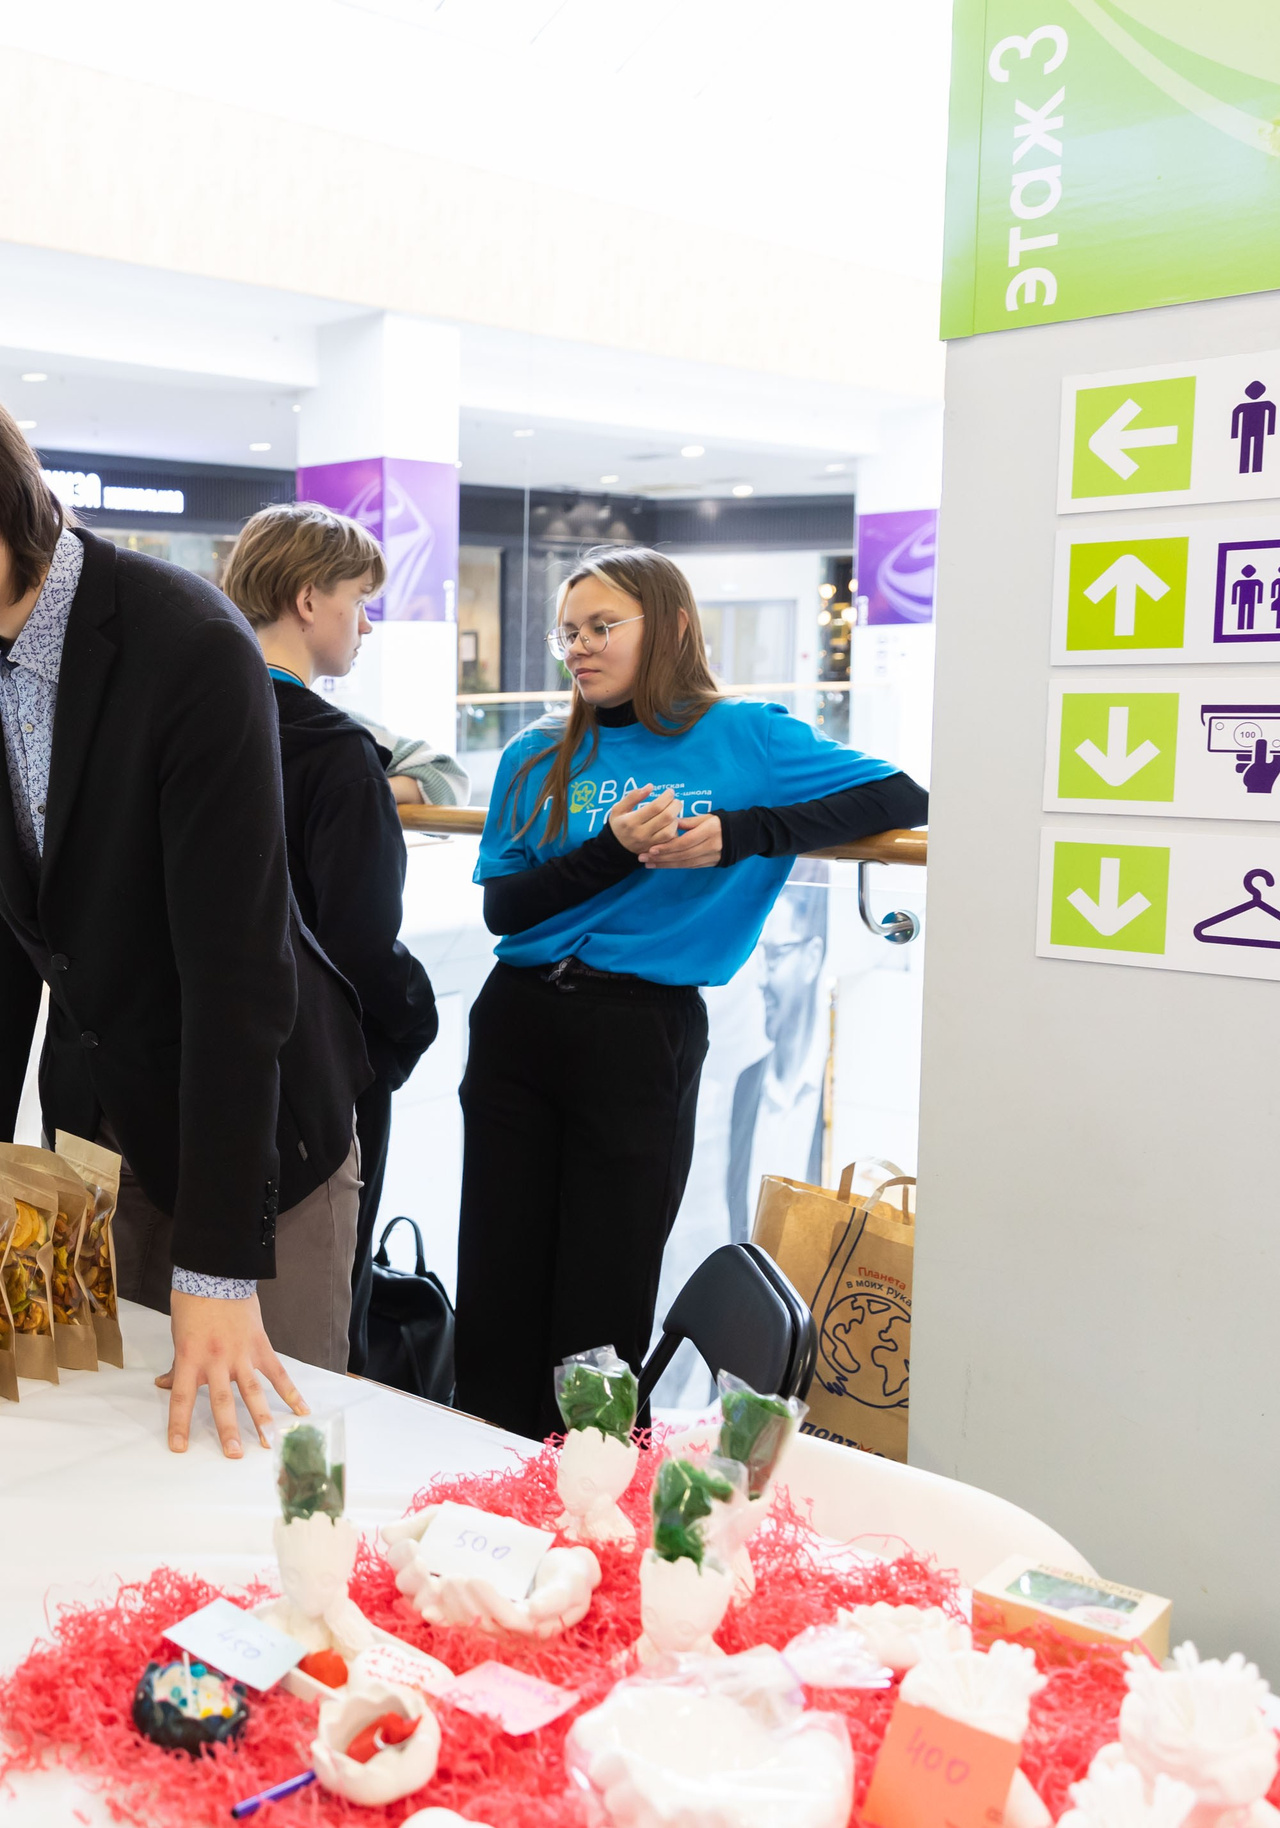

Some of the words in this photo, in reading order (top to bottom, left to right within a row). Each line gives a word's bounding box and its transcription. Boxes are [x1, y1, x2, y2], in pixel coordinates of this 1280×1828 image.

[988, 24, 1069, 83] 3
[1005, 85, 1066, 312] этаж
[1240, 731, 1256, 739] 100
[846, 1281, 853, 1289] в
[856, 1280, 884, 1291] моих
[886, 1287, 912, 1307] рука
[858, 1266, 907, 1290] Планета
[453, 1529, 512, 1560] 500
[905, 1724, 970, 1787] 400
